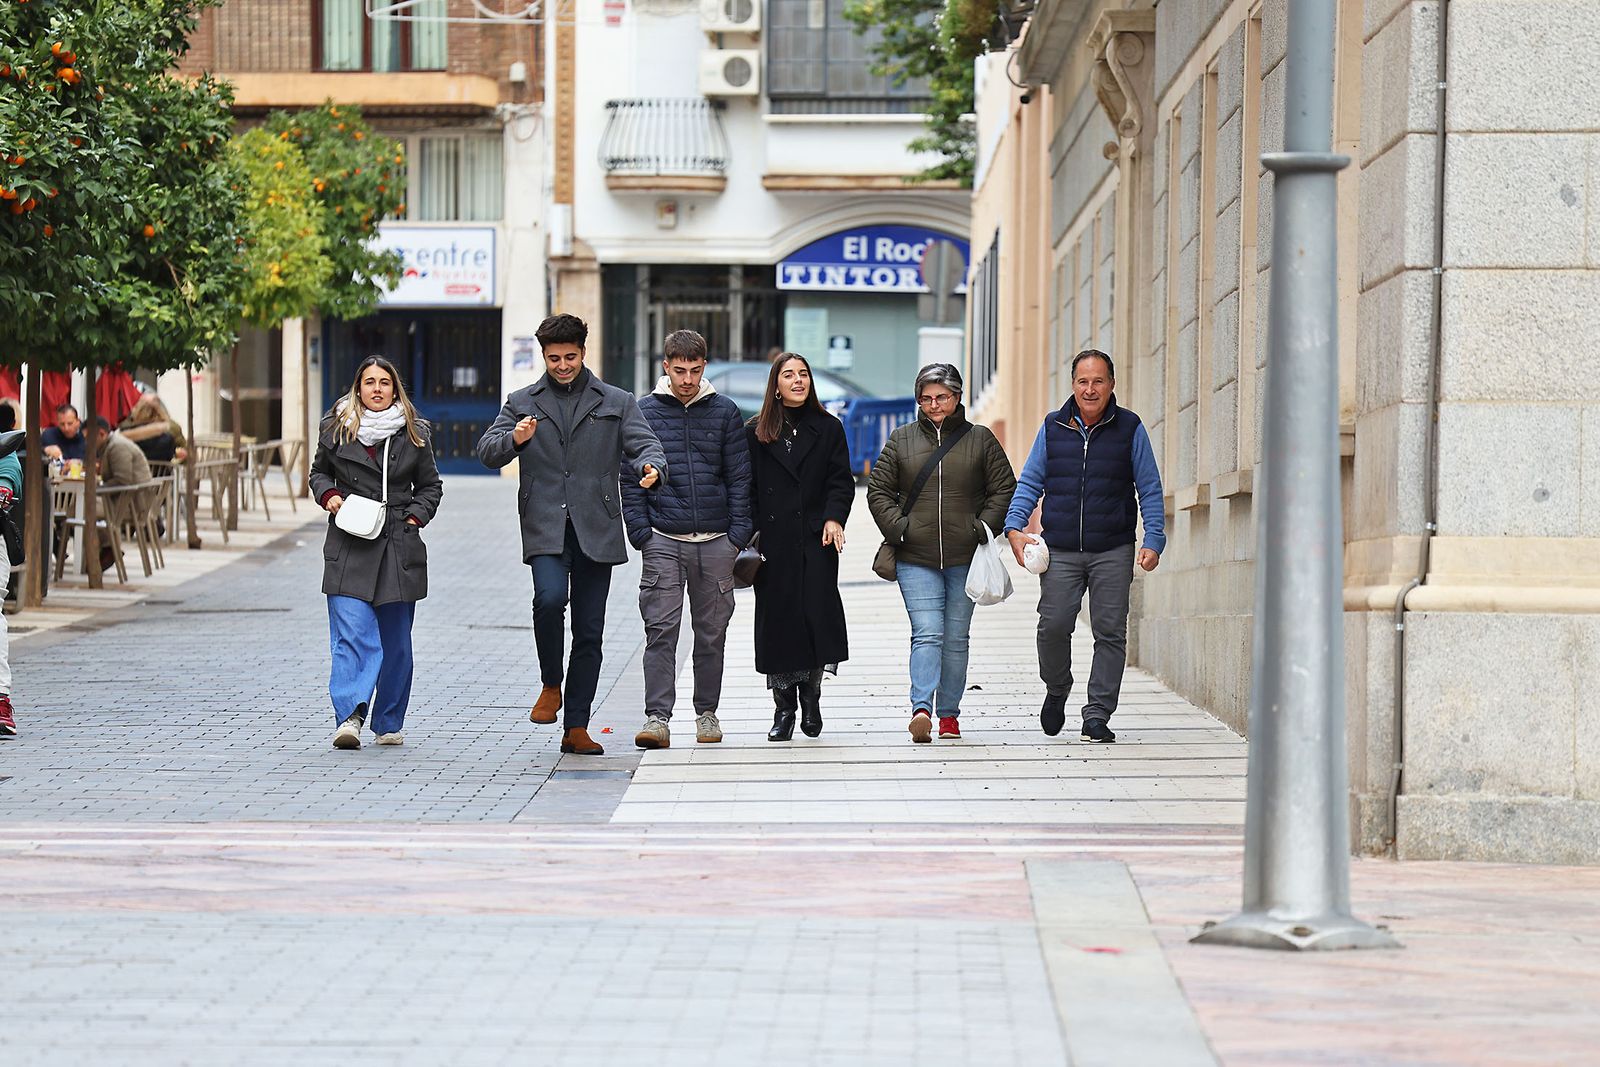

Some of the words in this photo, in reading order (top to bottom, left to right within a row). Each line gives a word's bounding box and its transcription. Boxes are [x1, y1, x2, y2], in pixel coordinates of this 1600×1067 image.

[843, 236, 868, 261] El
[875, 237, 934, 263] Roc
[784, 265, 928, 287] TINTOR
